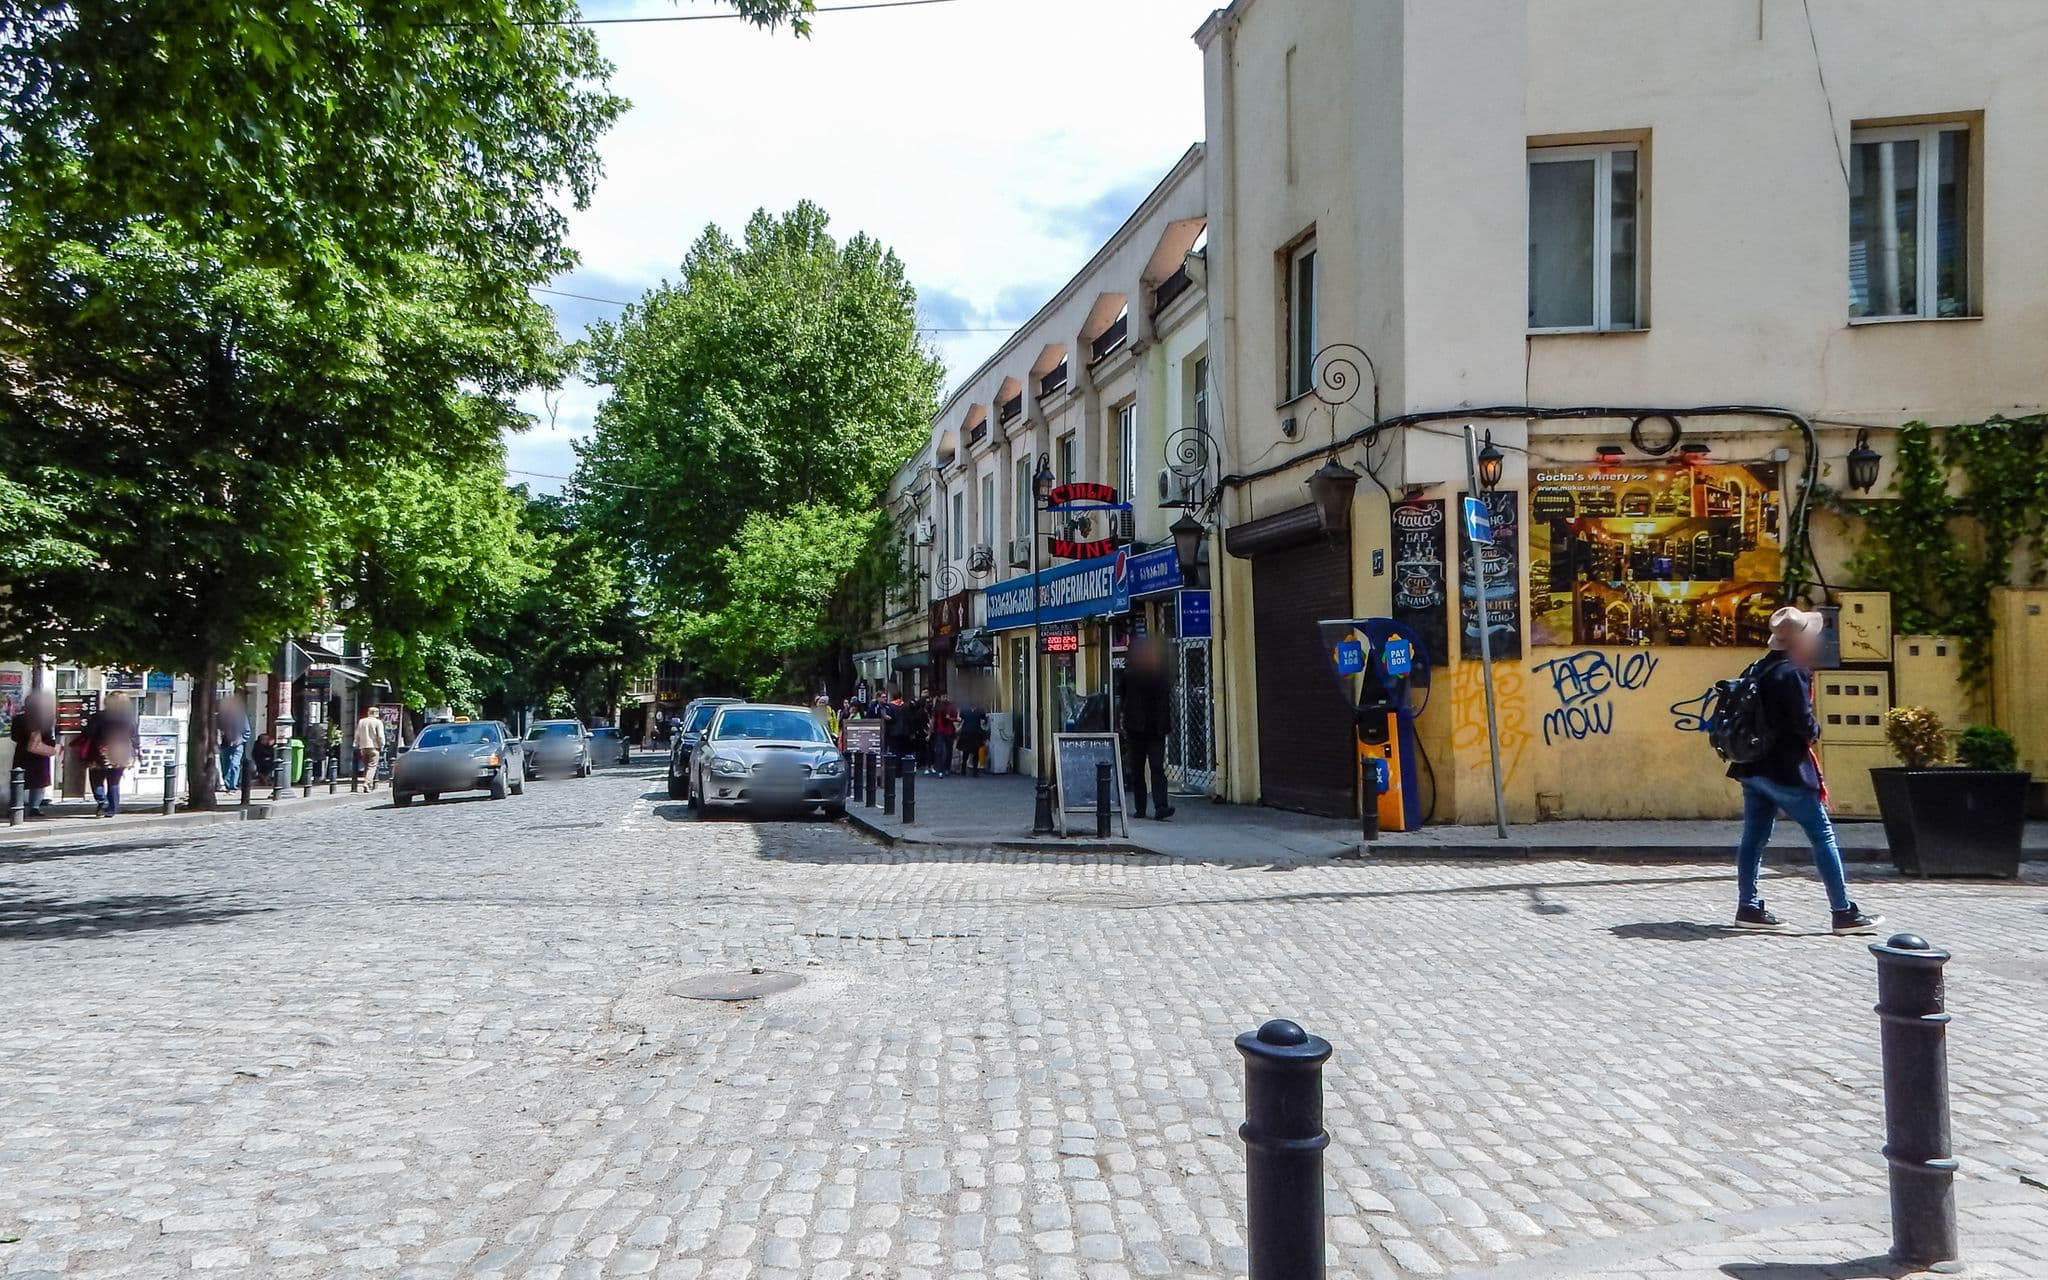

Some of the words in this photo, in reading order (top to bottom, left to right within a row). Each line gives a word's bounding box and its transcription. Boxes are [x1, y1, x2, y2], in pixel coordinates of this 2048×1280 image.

[1537, 472, 1585, 482] Gocha's
[1588, 472, 1629, 483] winery
[1055, 538, 1114, 559] WINE
[1051, 565, 1114, 607] SUPERMARKET
[1390, 650, 1405, 658] PAY
[1391, 657, 1406, 665] BOX
